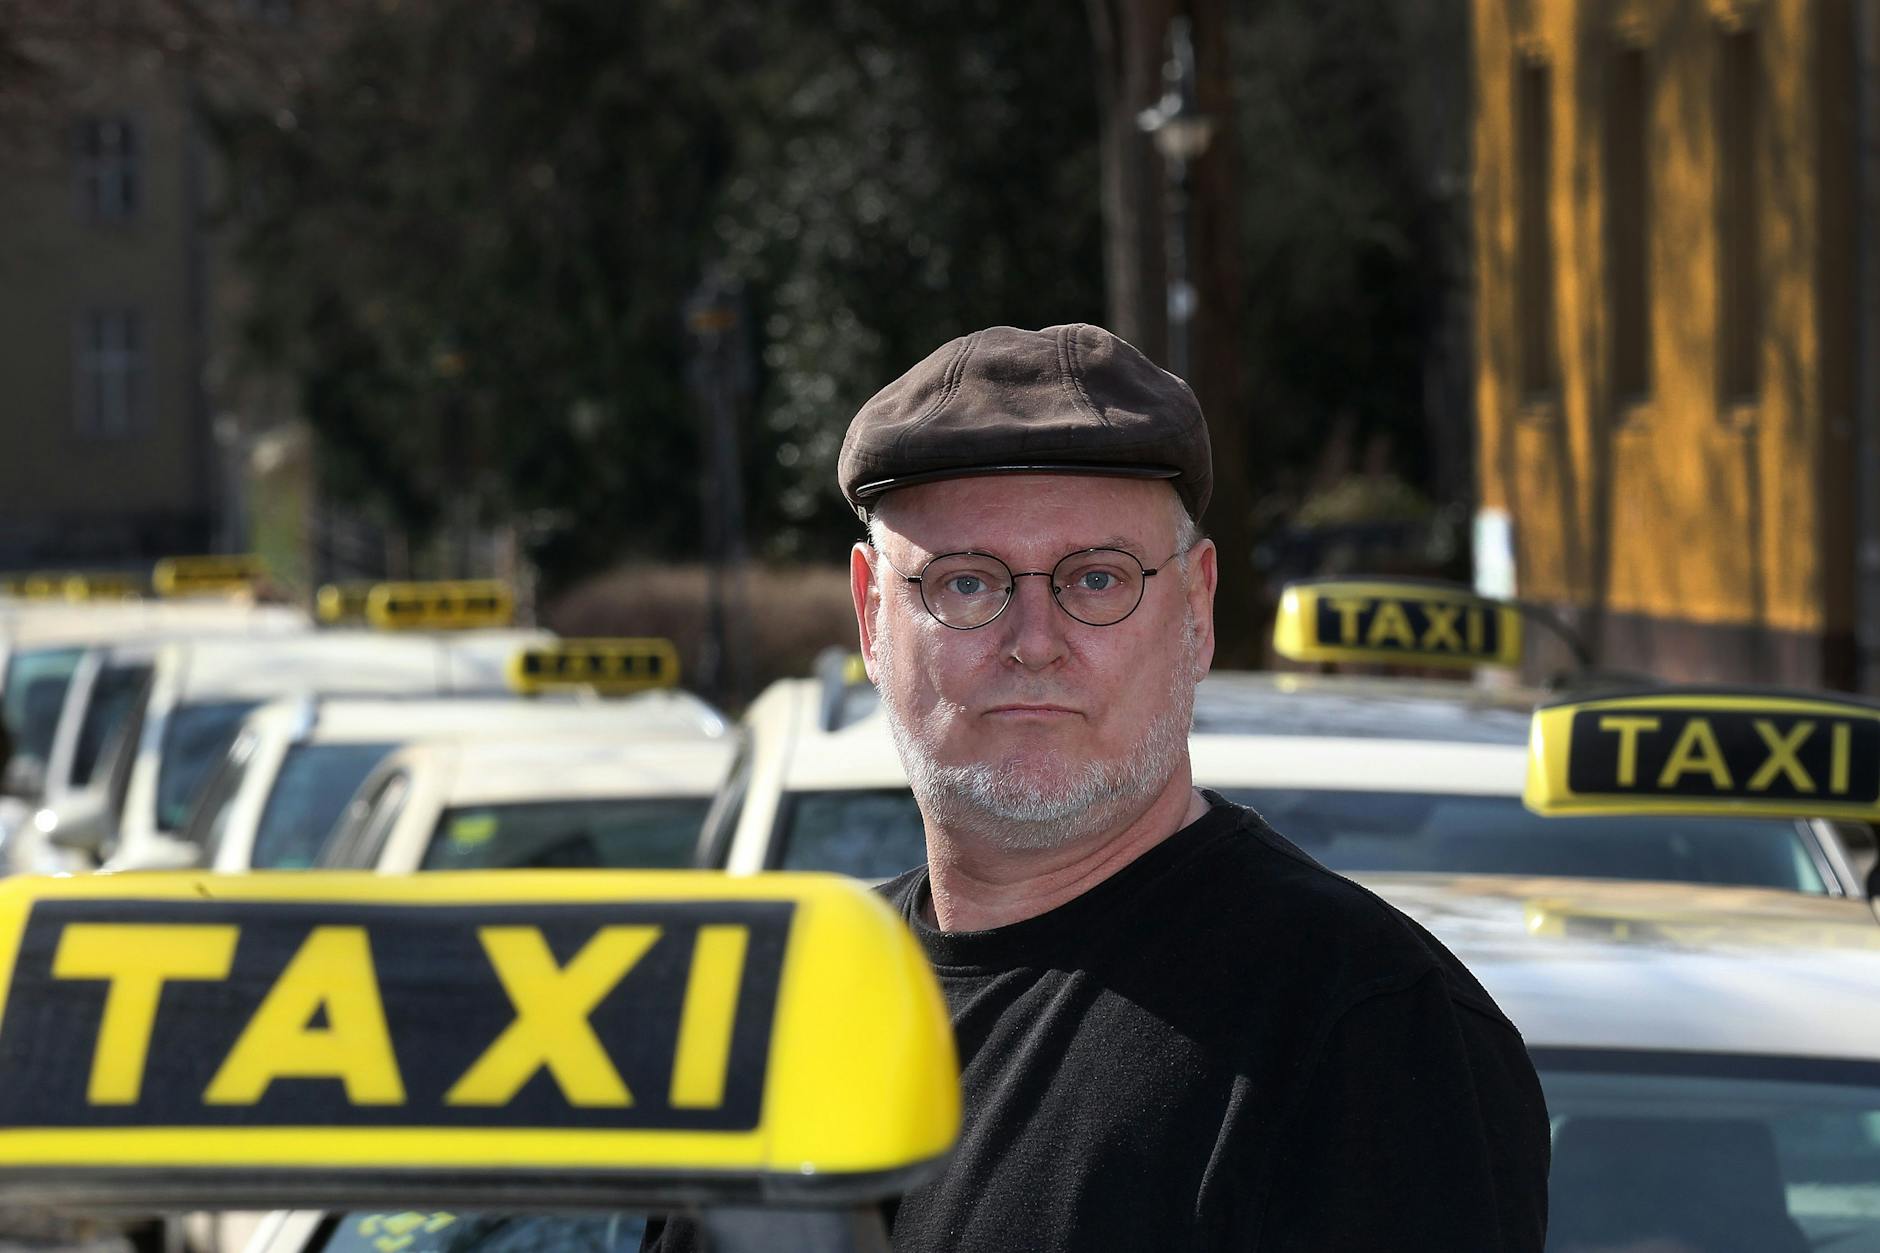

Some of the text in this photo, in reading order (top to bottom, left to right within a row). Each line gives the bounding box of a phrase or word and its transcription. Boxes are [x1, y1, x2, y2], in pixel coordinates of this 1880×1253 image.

[1328, 599, 1484, 649] TAXI
[1601, 716, 1850, 794] TAXI
[53, 924, 750, 1107] TAXI
